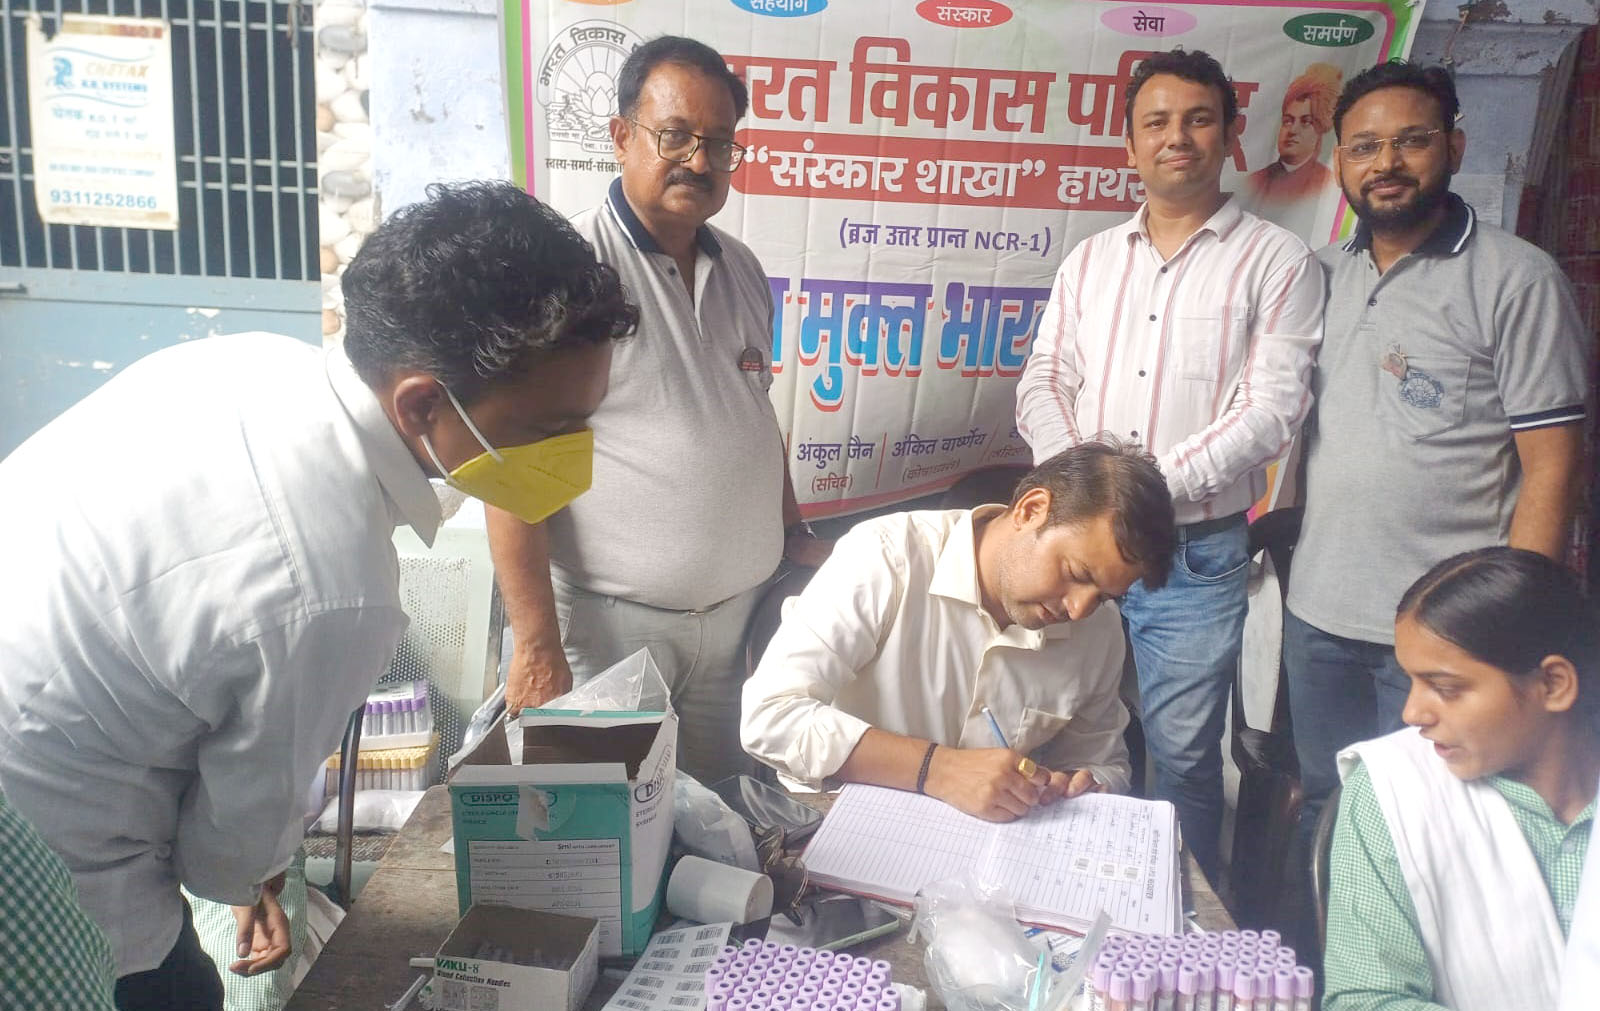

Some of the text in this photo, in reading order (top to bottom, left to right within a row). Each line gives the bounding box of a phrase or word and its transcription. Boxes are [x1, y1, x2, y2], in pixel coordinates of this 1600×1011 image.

[936, 1, 993, 23] संस्कार
[1132, 10, 1165, 32] सेवा
[1303, 19, 1358, 42] समर्पण
[540, 27, 626, 86] भारत विकास
[849, 36, 1056, 134] विकास
[744, 138, 909, 193] “संस्कार
[915, 158, 1046, 198] शाखा”
[50, 189, 157, 209] 9311252866
[839, 217, 1051, 258] (ब्रज उत्तर प्रान्त NCR-1)
[797, 278, 934, 412] मुक्त
[797, 434, 875, 469] अंकुल जैन
[892, 432, 938, 457] अंकित
[811, 472, 853, 493] (सचिव)
